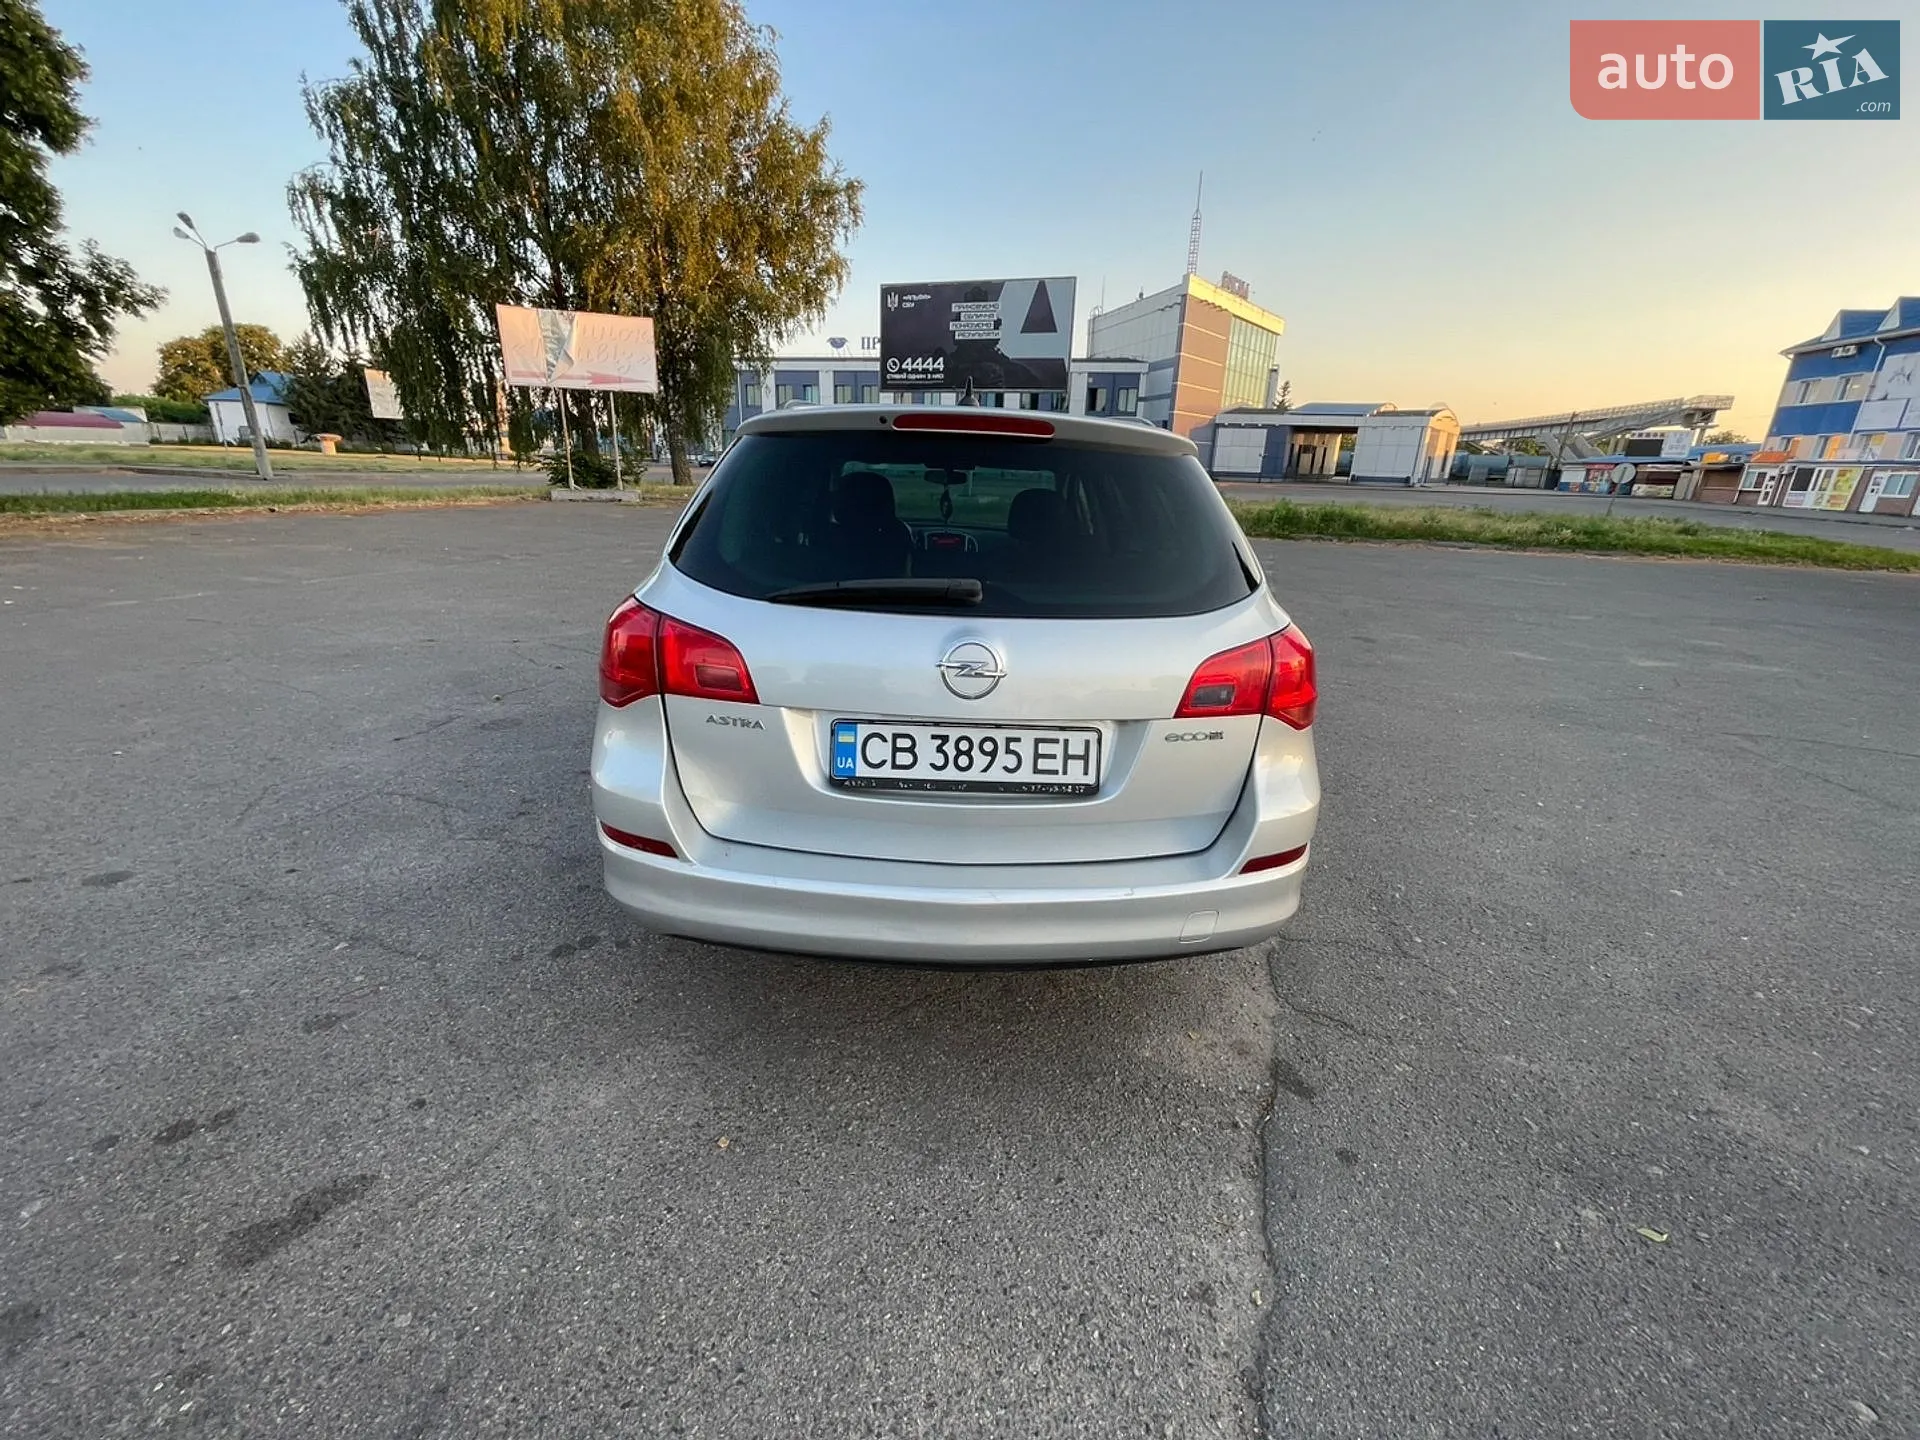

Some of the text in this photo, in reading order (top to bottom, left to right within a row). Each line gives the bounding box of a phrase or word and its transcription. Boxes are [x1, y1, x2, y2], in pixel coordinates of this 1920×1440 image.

[901, 357, 944, 371] 4444
[706, 714, 766, 730] ASTRA
[861, 732, 1090, 776] CB 3895 EH
[837, 757, 855, 769] UA
